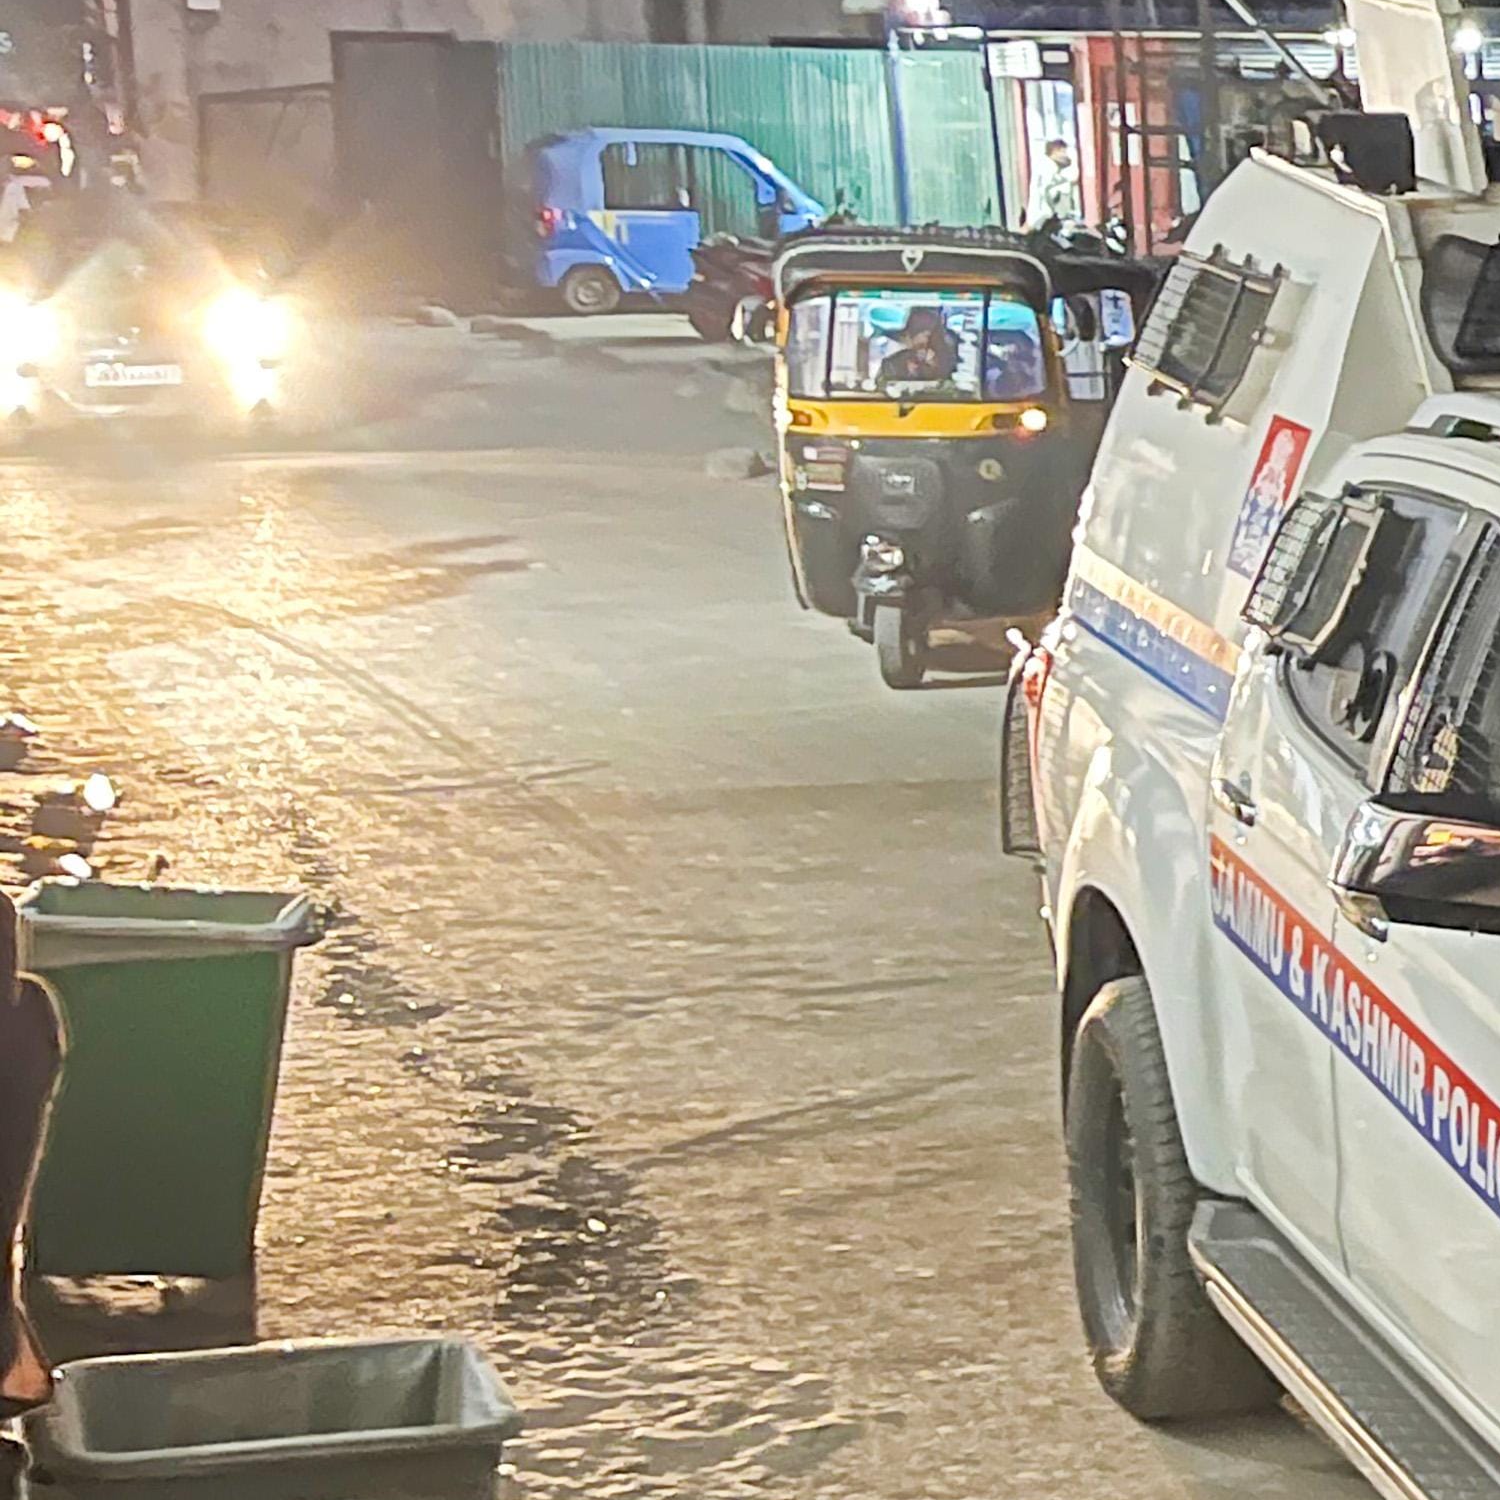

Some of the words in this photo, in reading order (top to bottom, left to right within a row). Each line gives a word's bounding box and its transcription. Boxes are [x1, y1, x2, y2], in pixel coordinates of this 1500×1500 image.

[1212, 855, 1285, 977] JAMMU
[1289, 925, 1305, 998] &
[1311, 944, 1427, 1128] KASHMIR
